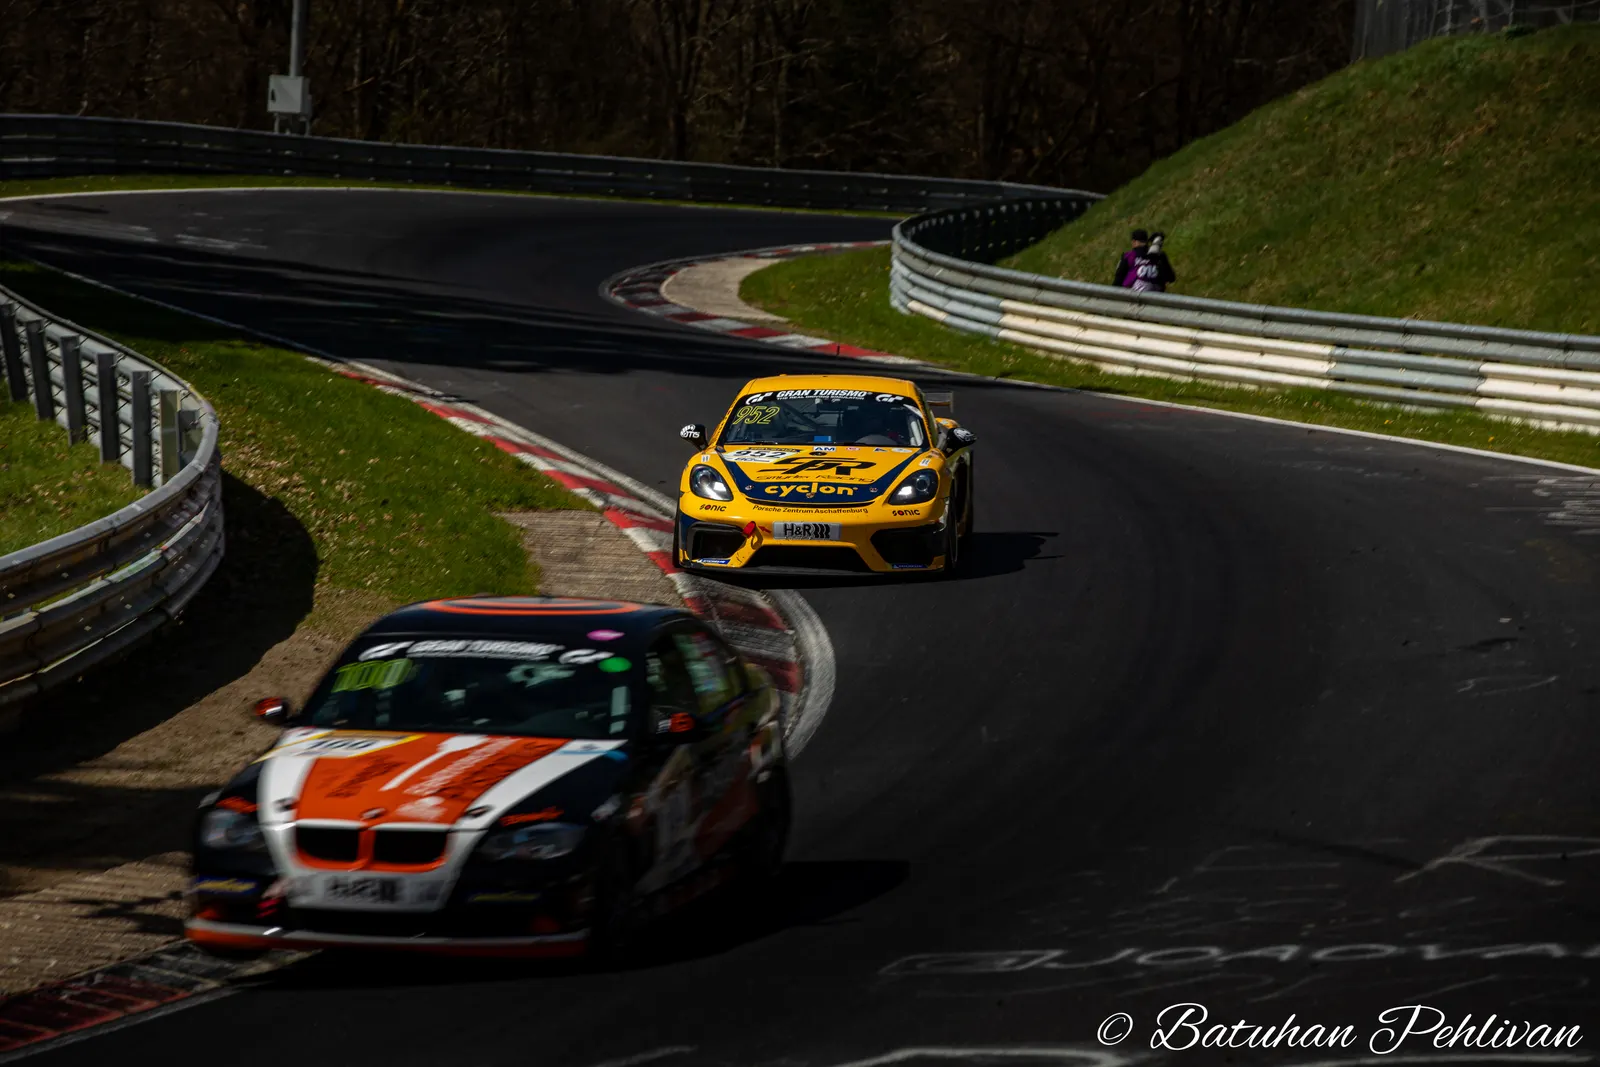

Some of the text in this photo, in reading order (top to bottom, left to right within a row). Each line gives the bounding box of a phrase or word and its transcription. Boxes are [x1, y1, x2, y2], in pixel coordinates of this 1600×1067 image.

[776, 389, 868, 399] GRAN TURISMO
[733, 405, 780, 425] 952
[733, 450, 787, 458] 952
[764, 482, 854, 498] cyclon
[752, 505, 782, 513] Porsche
[783, 523, 812, 538] H&R
